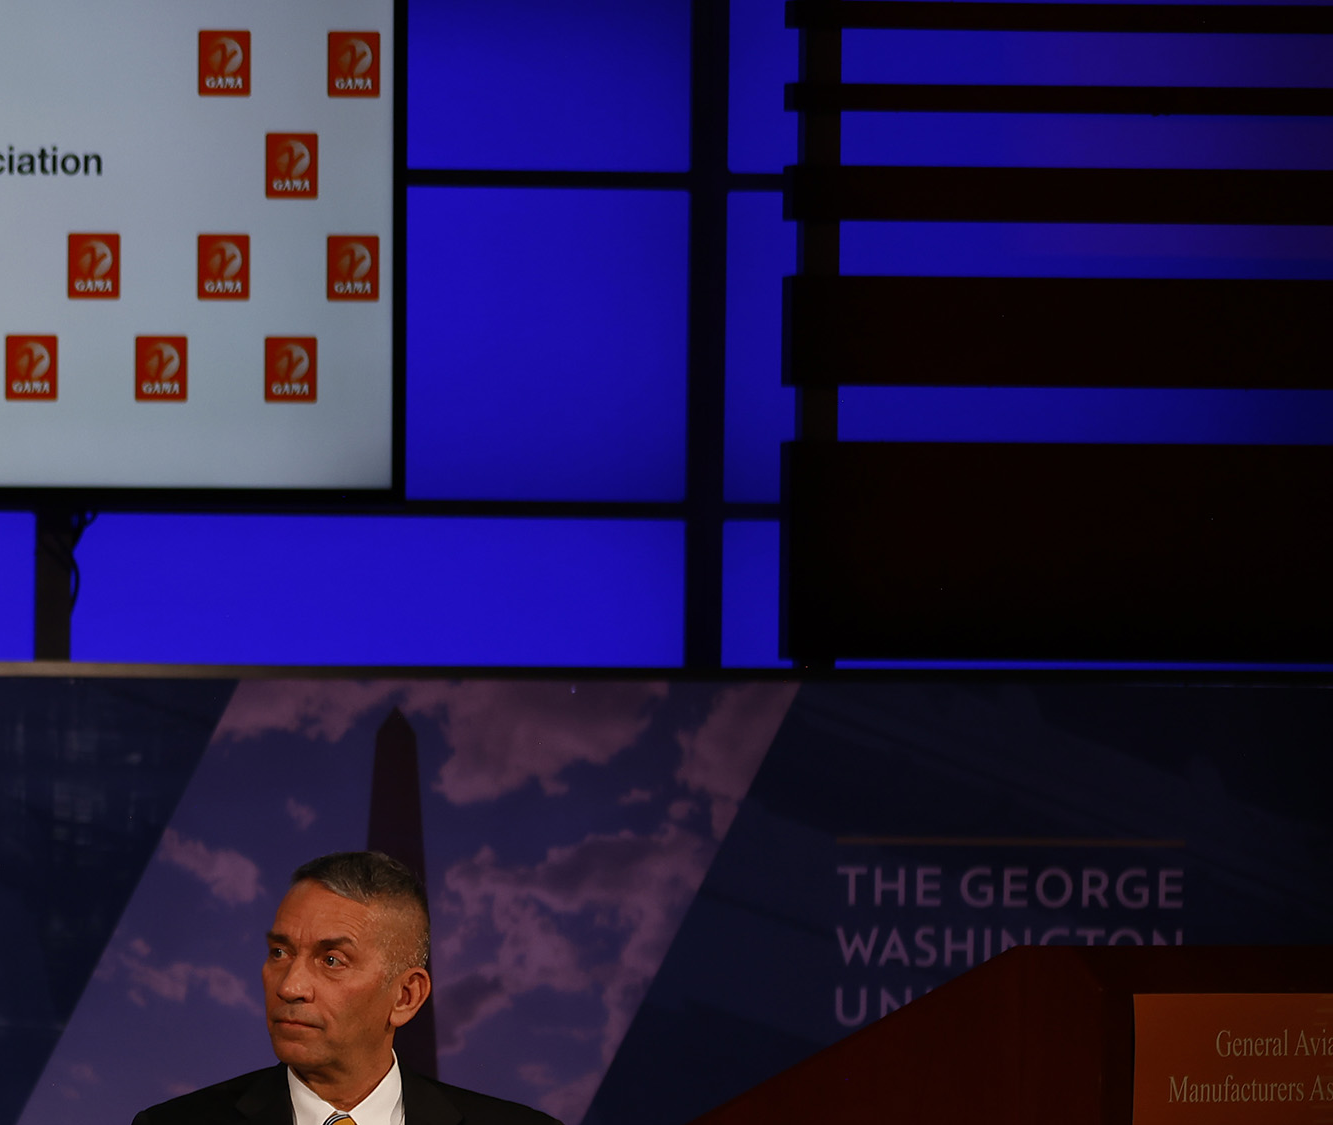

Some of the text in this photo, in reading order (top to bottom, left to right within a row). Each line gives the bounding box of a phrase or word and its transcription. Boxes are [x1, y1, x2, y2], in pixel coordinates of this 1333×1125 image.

[205, 76, 243, 89] GAMA
[335, 77, 372, 90] GAMA
[272, 178, 310, 192] GAMA
[74, 278, 113, 292] GAMA
[204, 279, 242, 293] GAMA
[333, 280, 372, 294] GAMA
[11, 380, 50, 394] GAMA
[141, 381, 180, 395] GAMA
[271, 382, 309, 395] GAMA
[836, 865, 1185, 909] THE GEORGE
[1216, 1028, 1333, 1058] General Avia
[1167, 1073, 1305, 1104] Manufacturers
